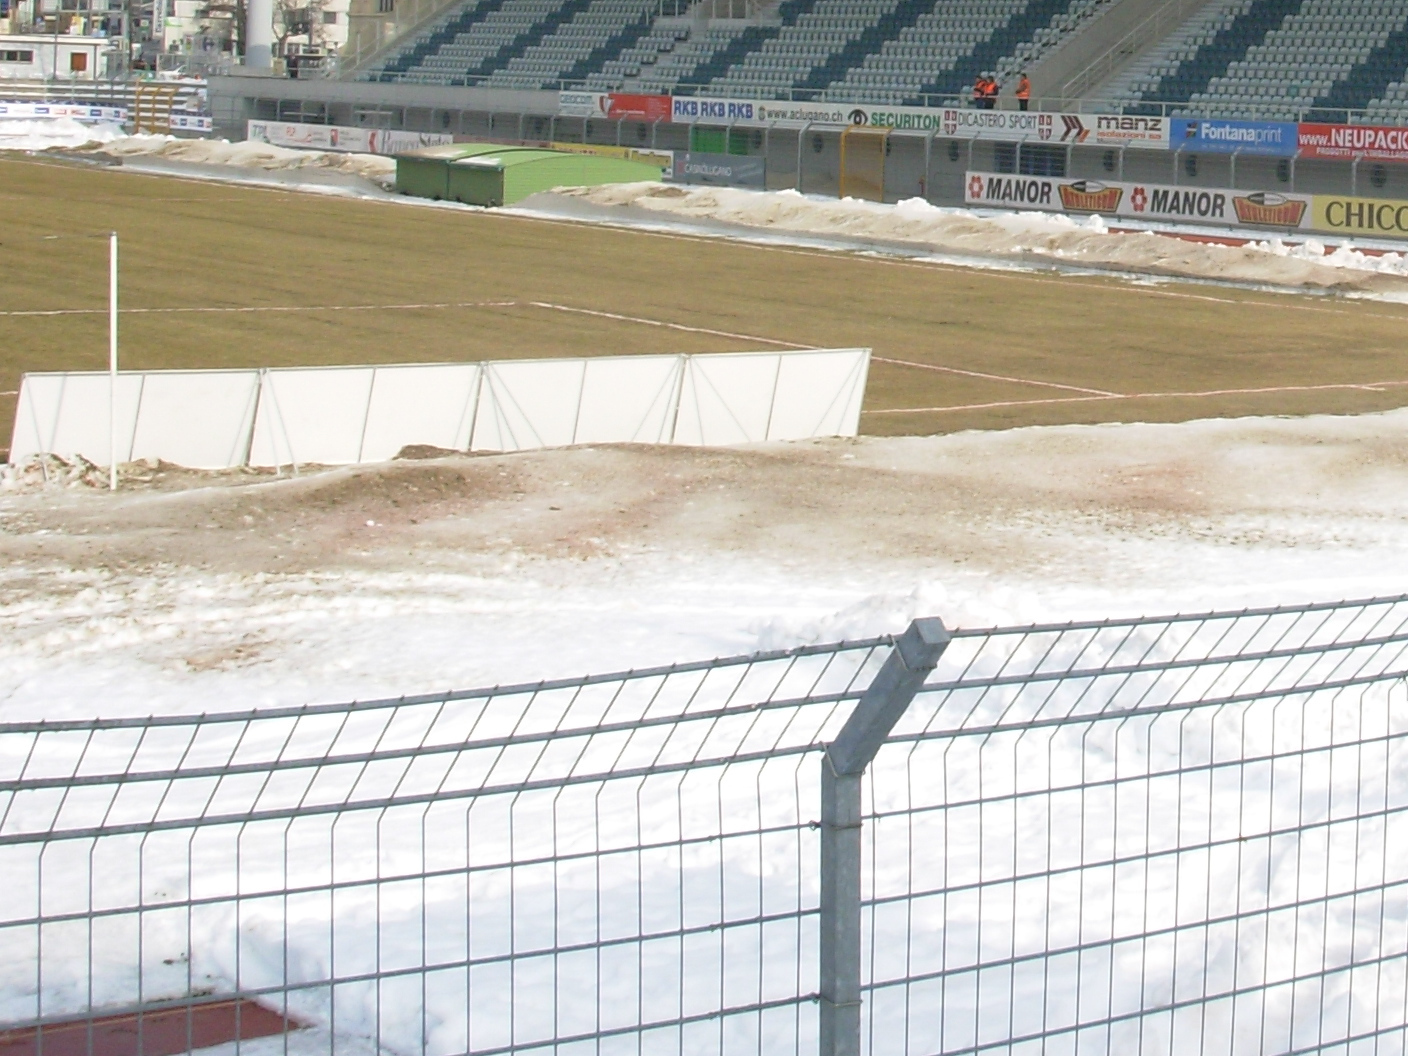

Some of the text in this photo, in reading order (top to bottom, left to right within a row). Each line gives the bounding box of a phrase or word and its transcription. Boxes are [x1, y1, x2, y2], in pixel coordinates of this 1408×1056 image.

[674, 100, 698, 115] RKB
[701, 101, 725, 117] RKB
[728, 103, 753, 119] RKB
[767, 108, 843, 123] www.aclugano.ch
[871, 112, 940, 130] SECURITON
[958, 113, 1006, 129] DICASTERO
[1009, 115, 1037, 130] SPORT
[1097, 116, 1162, 131] manz
[1201, 122, 1282, 145] Fontanaprint
[986, 177, 1052, 204] MANOR
[1151, 189, 1226, 218] MANOR
